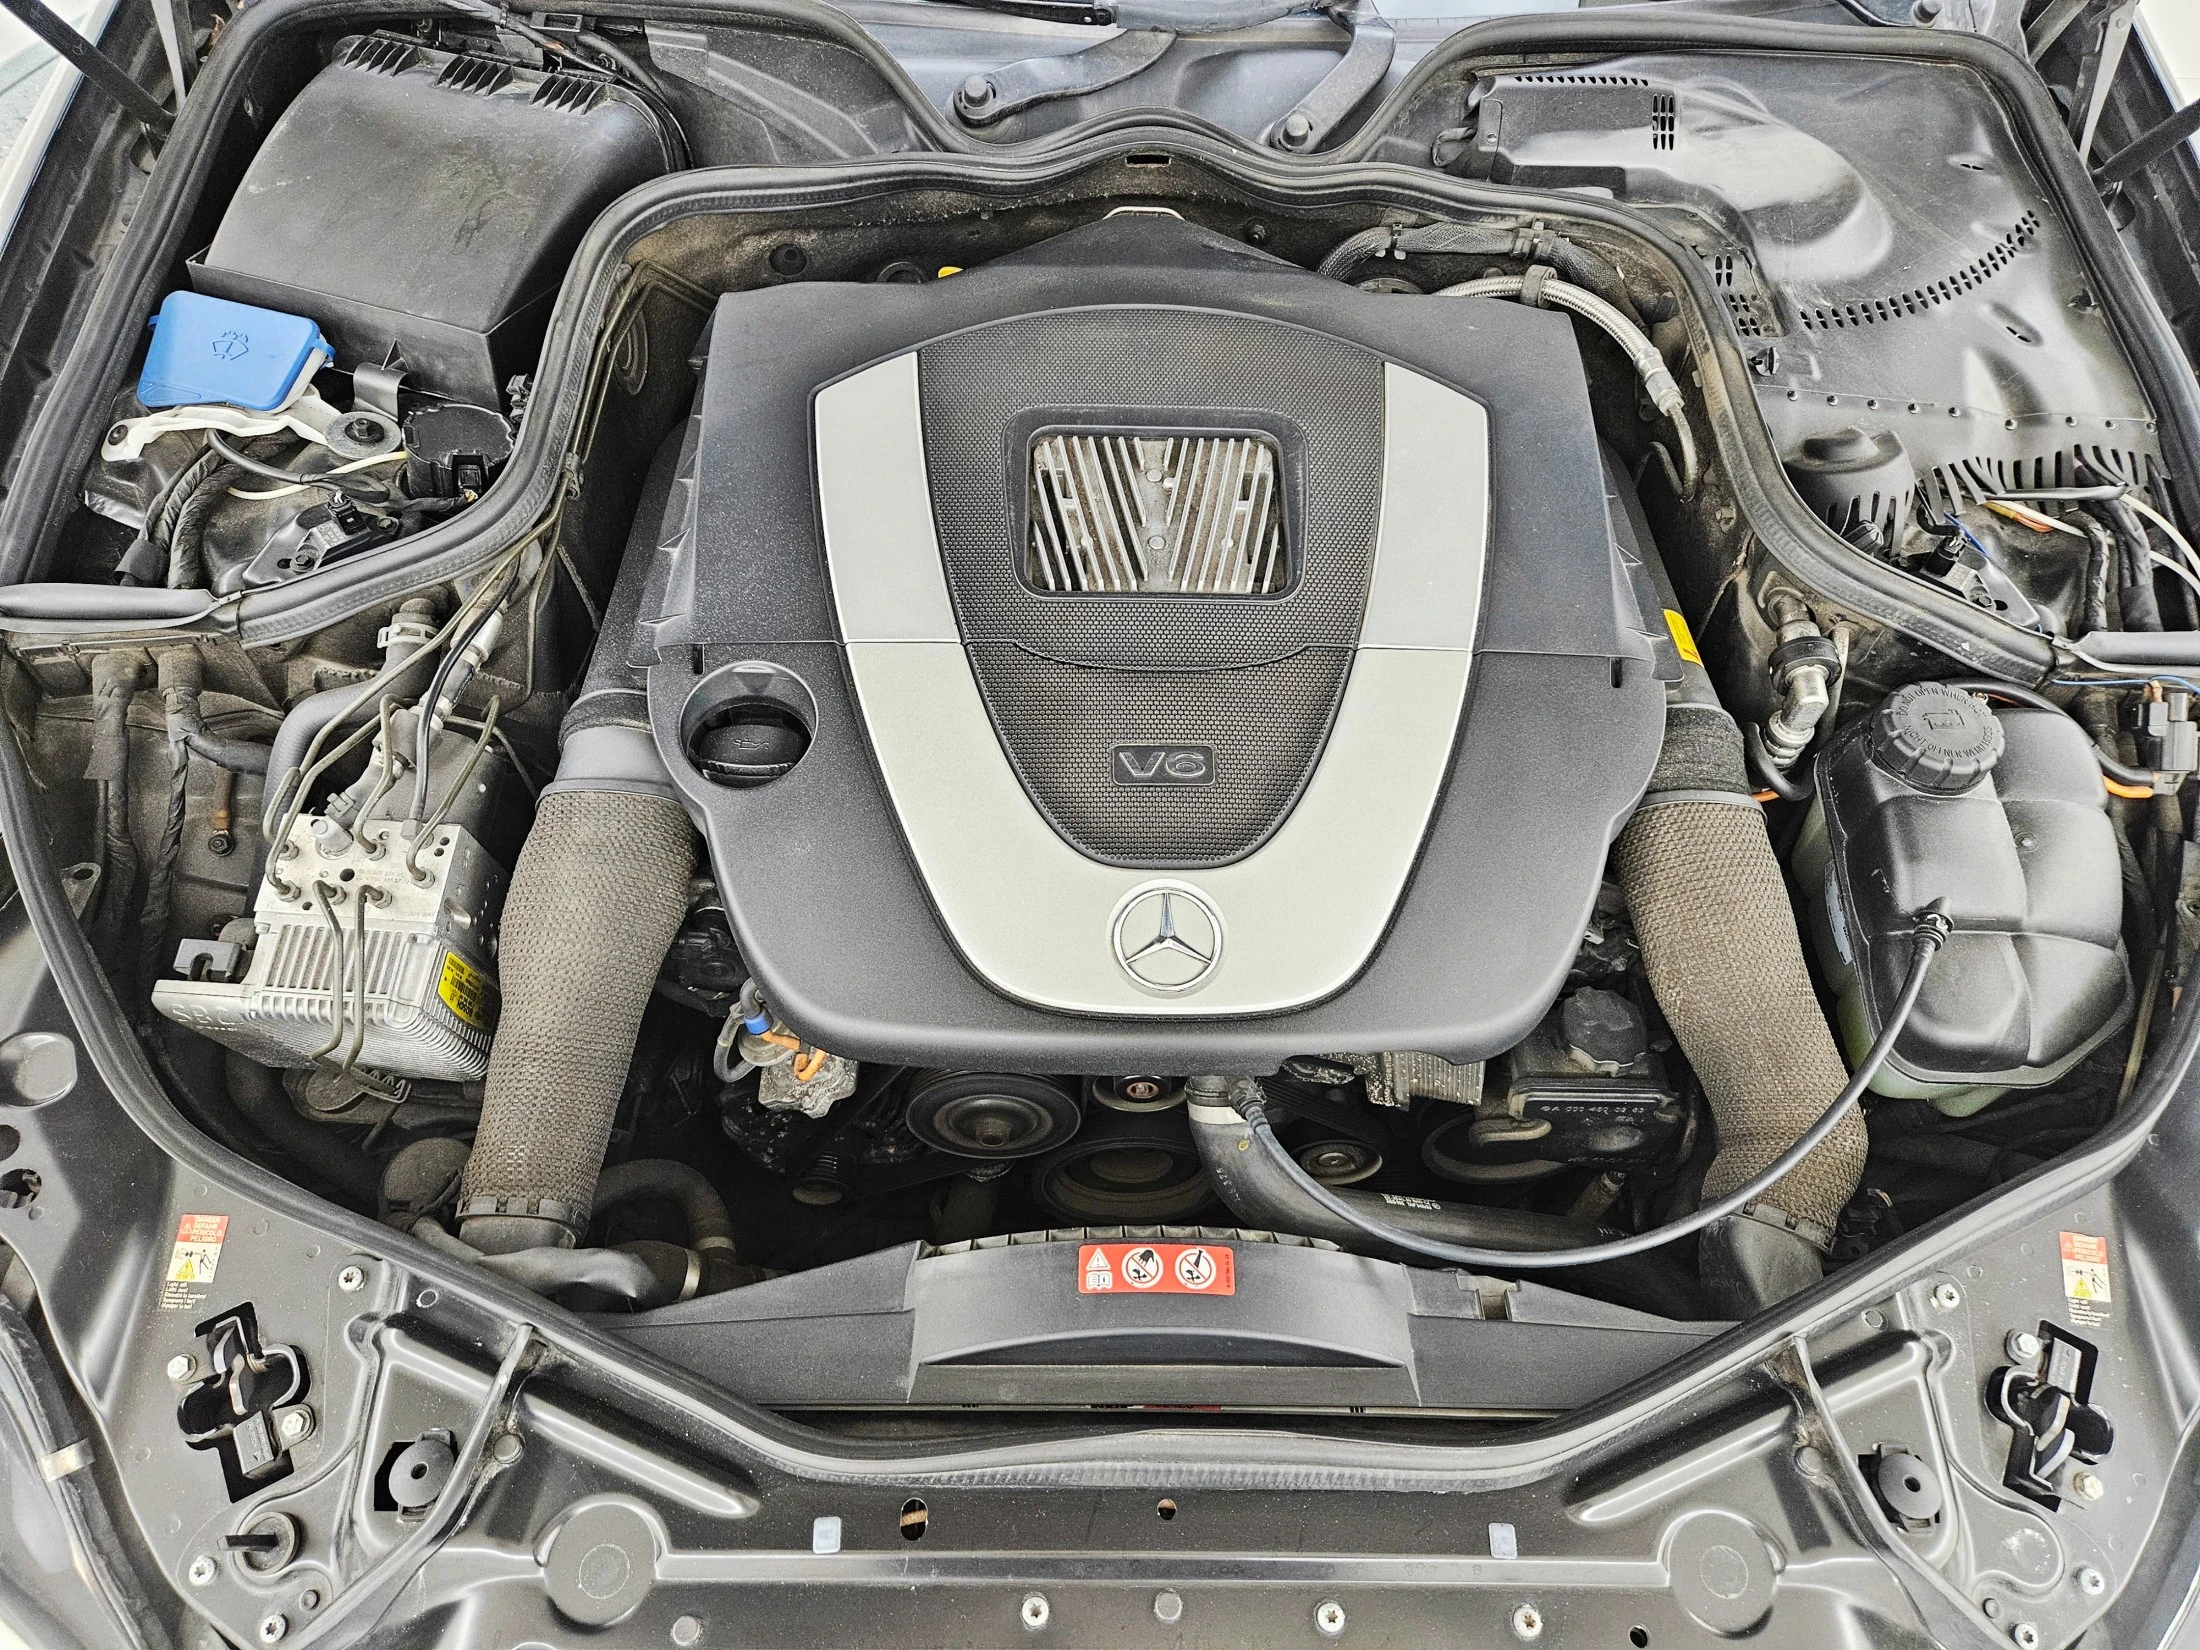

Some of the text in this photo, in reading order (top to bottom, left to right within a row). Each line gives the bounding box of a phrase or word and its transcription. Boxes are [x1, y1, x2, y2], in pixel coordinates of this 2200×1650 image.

[1901, 693, 1917, 708] NOT
[1914, 687, 1939, 697] OPEN
[1940, 688, 1969, 704] WHEN
[1119, 751, 1207, 778] V6
